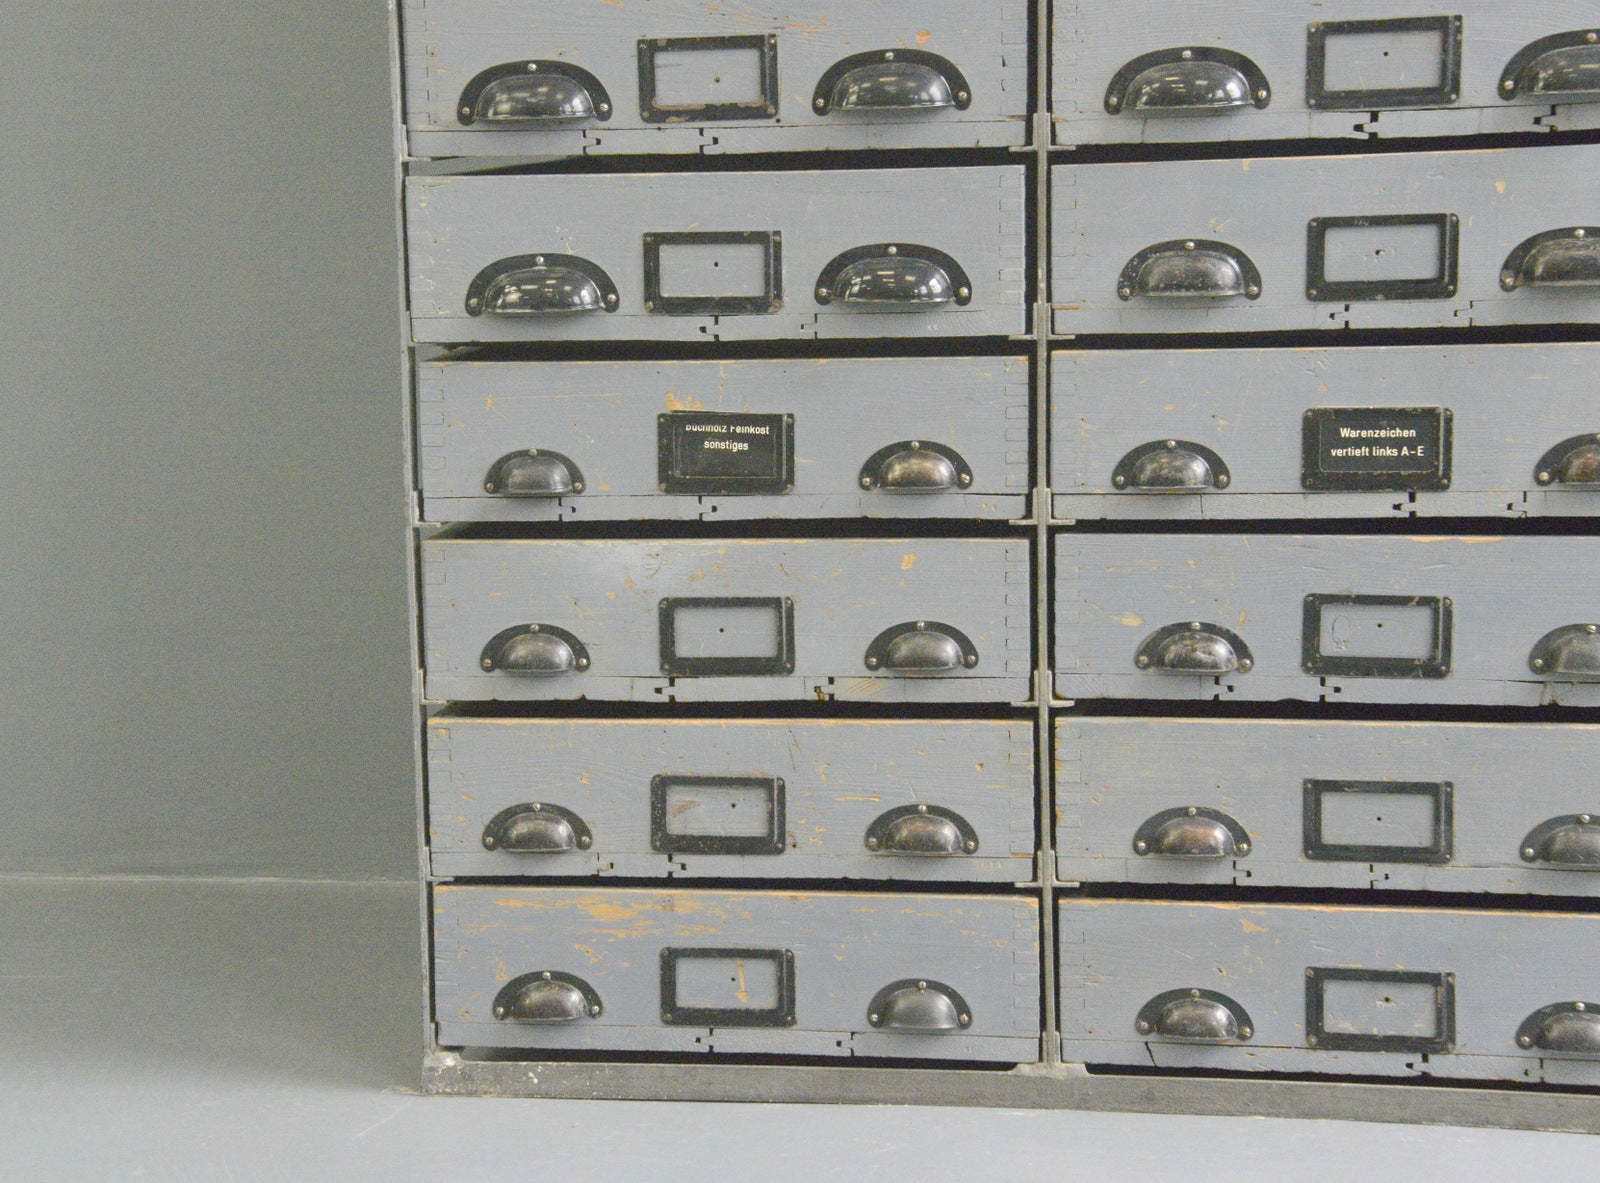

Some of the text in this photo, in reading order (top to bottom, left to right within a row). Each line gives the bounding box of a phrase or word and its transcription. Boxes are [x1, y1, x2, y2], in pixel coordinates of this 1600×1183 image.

[1340, 427, 1417, 438] Warenzeichen
[703, 440, 749, 452] sonstiges
[1330, 446, 1370, 457] vertieft
[1372, 446, 1399, 457] links
